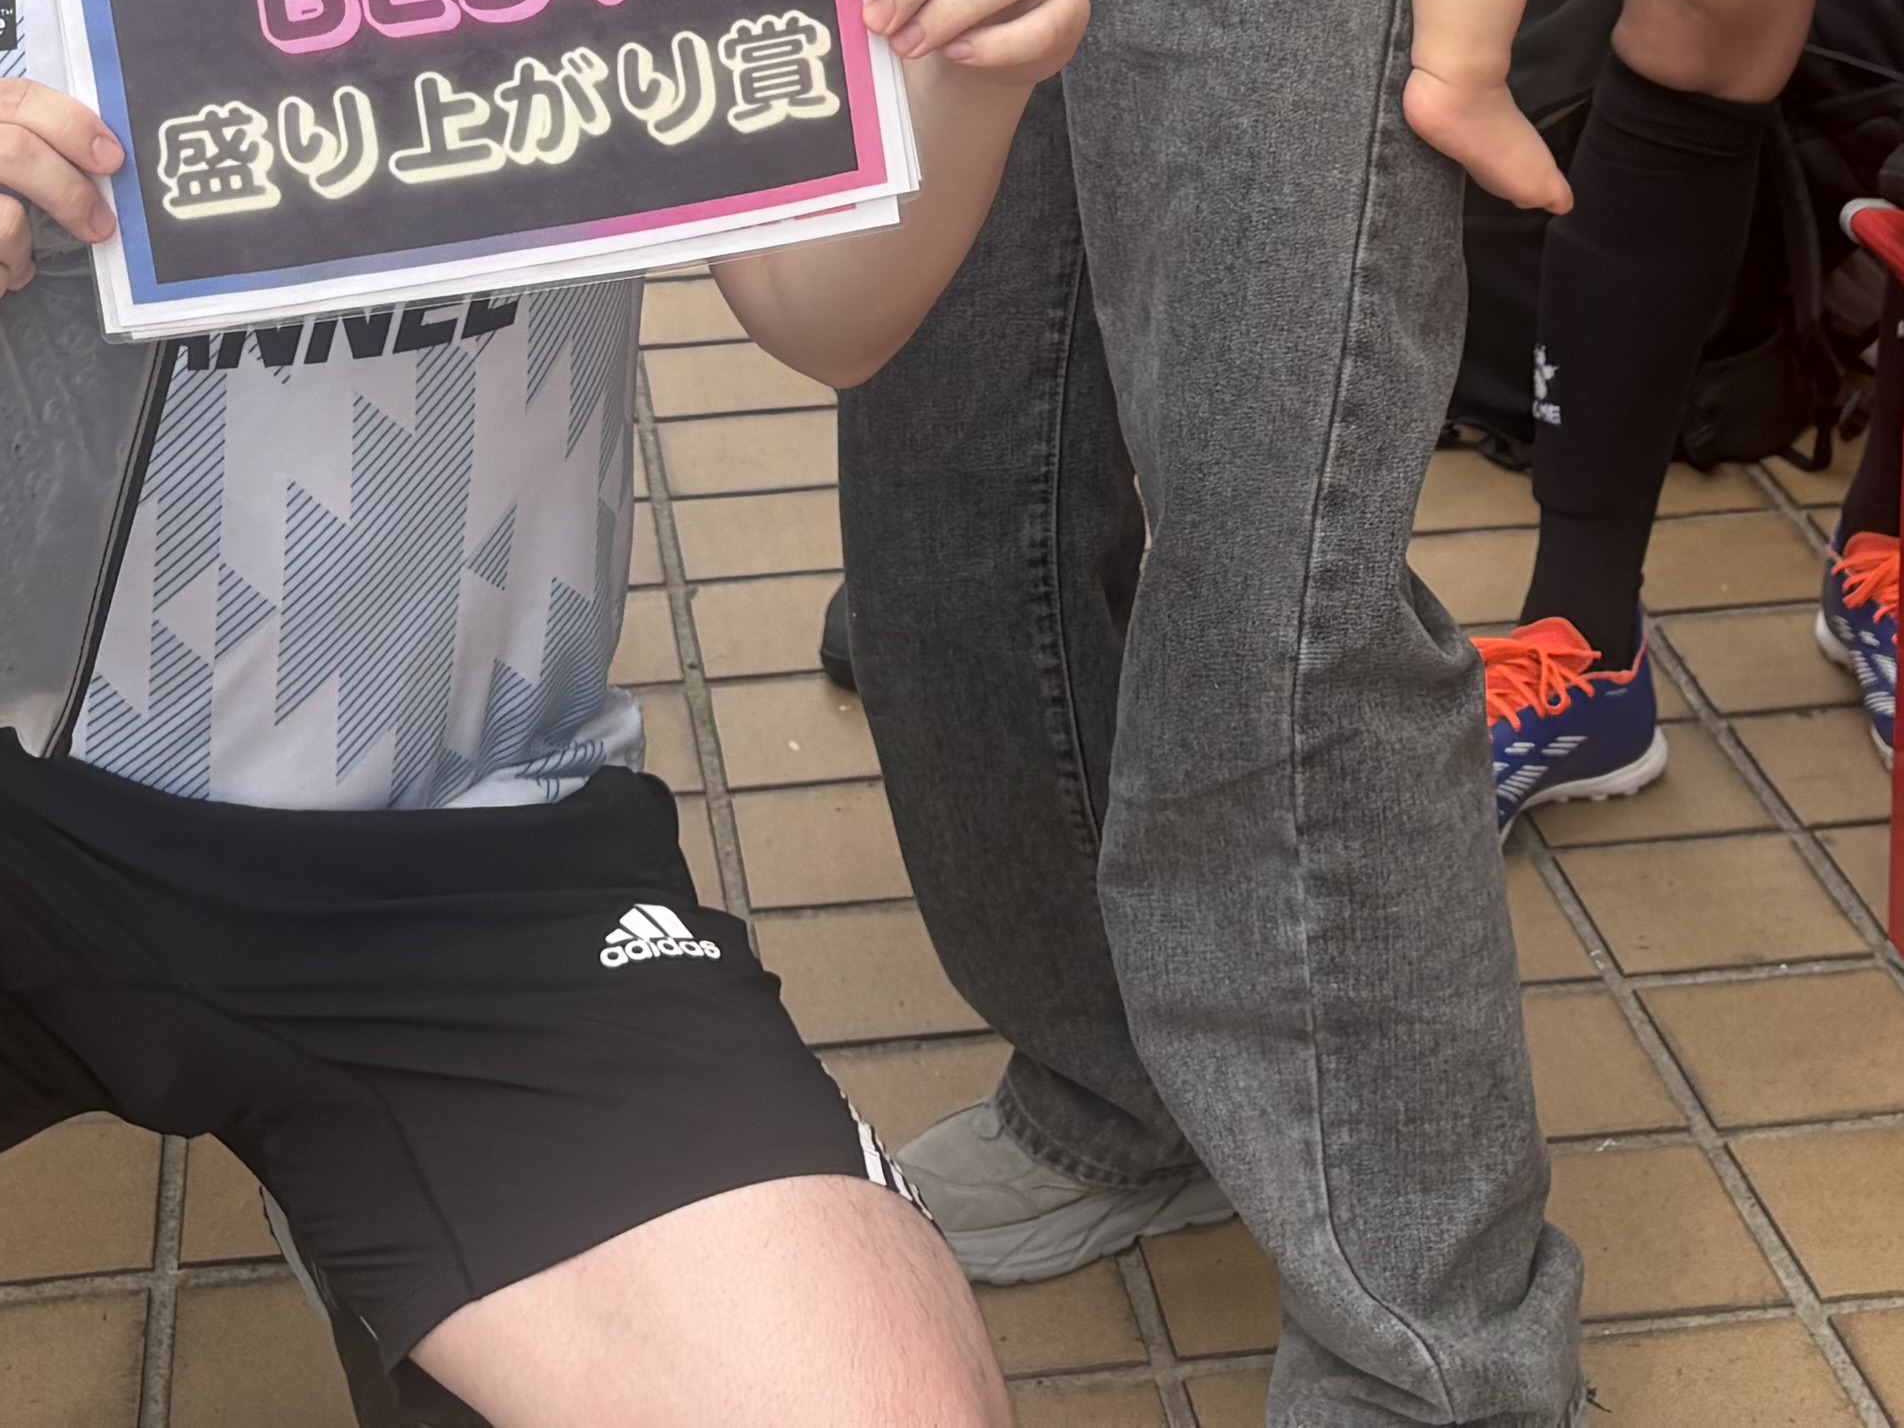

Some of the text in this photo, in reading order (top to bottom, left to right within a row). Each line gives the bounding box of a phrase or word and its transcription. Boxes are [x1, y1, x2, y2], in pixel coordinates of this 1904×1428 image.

[157, 11, 844, 223] 盛り上がり賞
[599, 938, 721, 968] adidas
